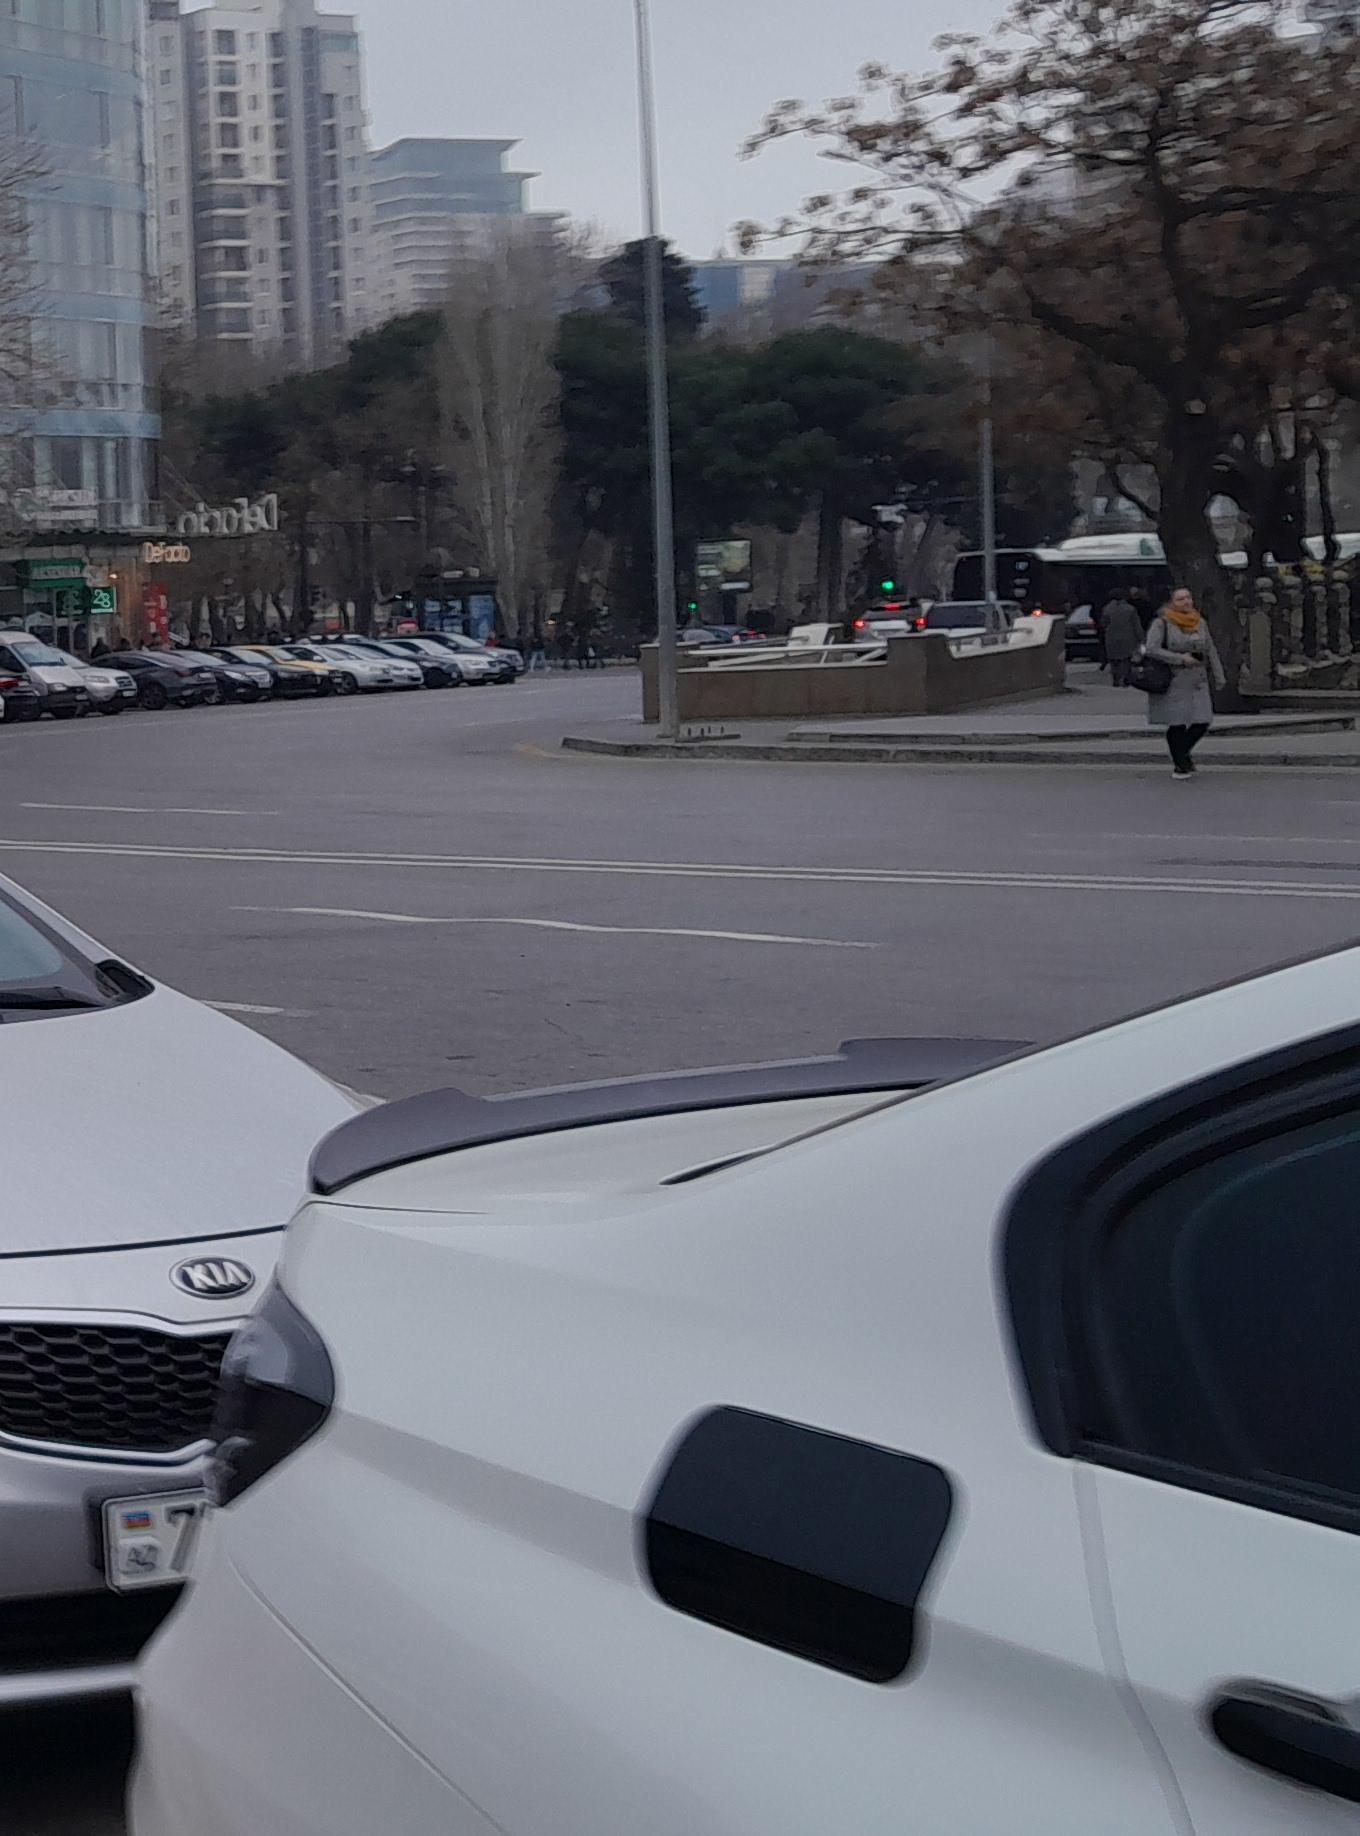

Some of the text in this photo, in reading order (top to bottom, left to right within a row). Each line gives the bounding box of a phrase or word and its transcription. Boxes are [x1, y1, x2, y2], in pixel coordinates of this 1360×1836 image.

[93, 589, 111, 608] 28
[182, 1260, 250, 1291] KIA
[164, 1502, 202, 1572] 7
